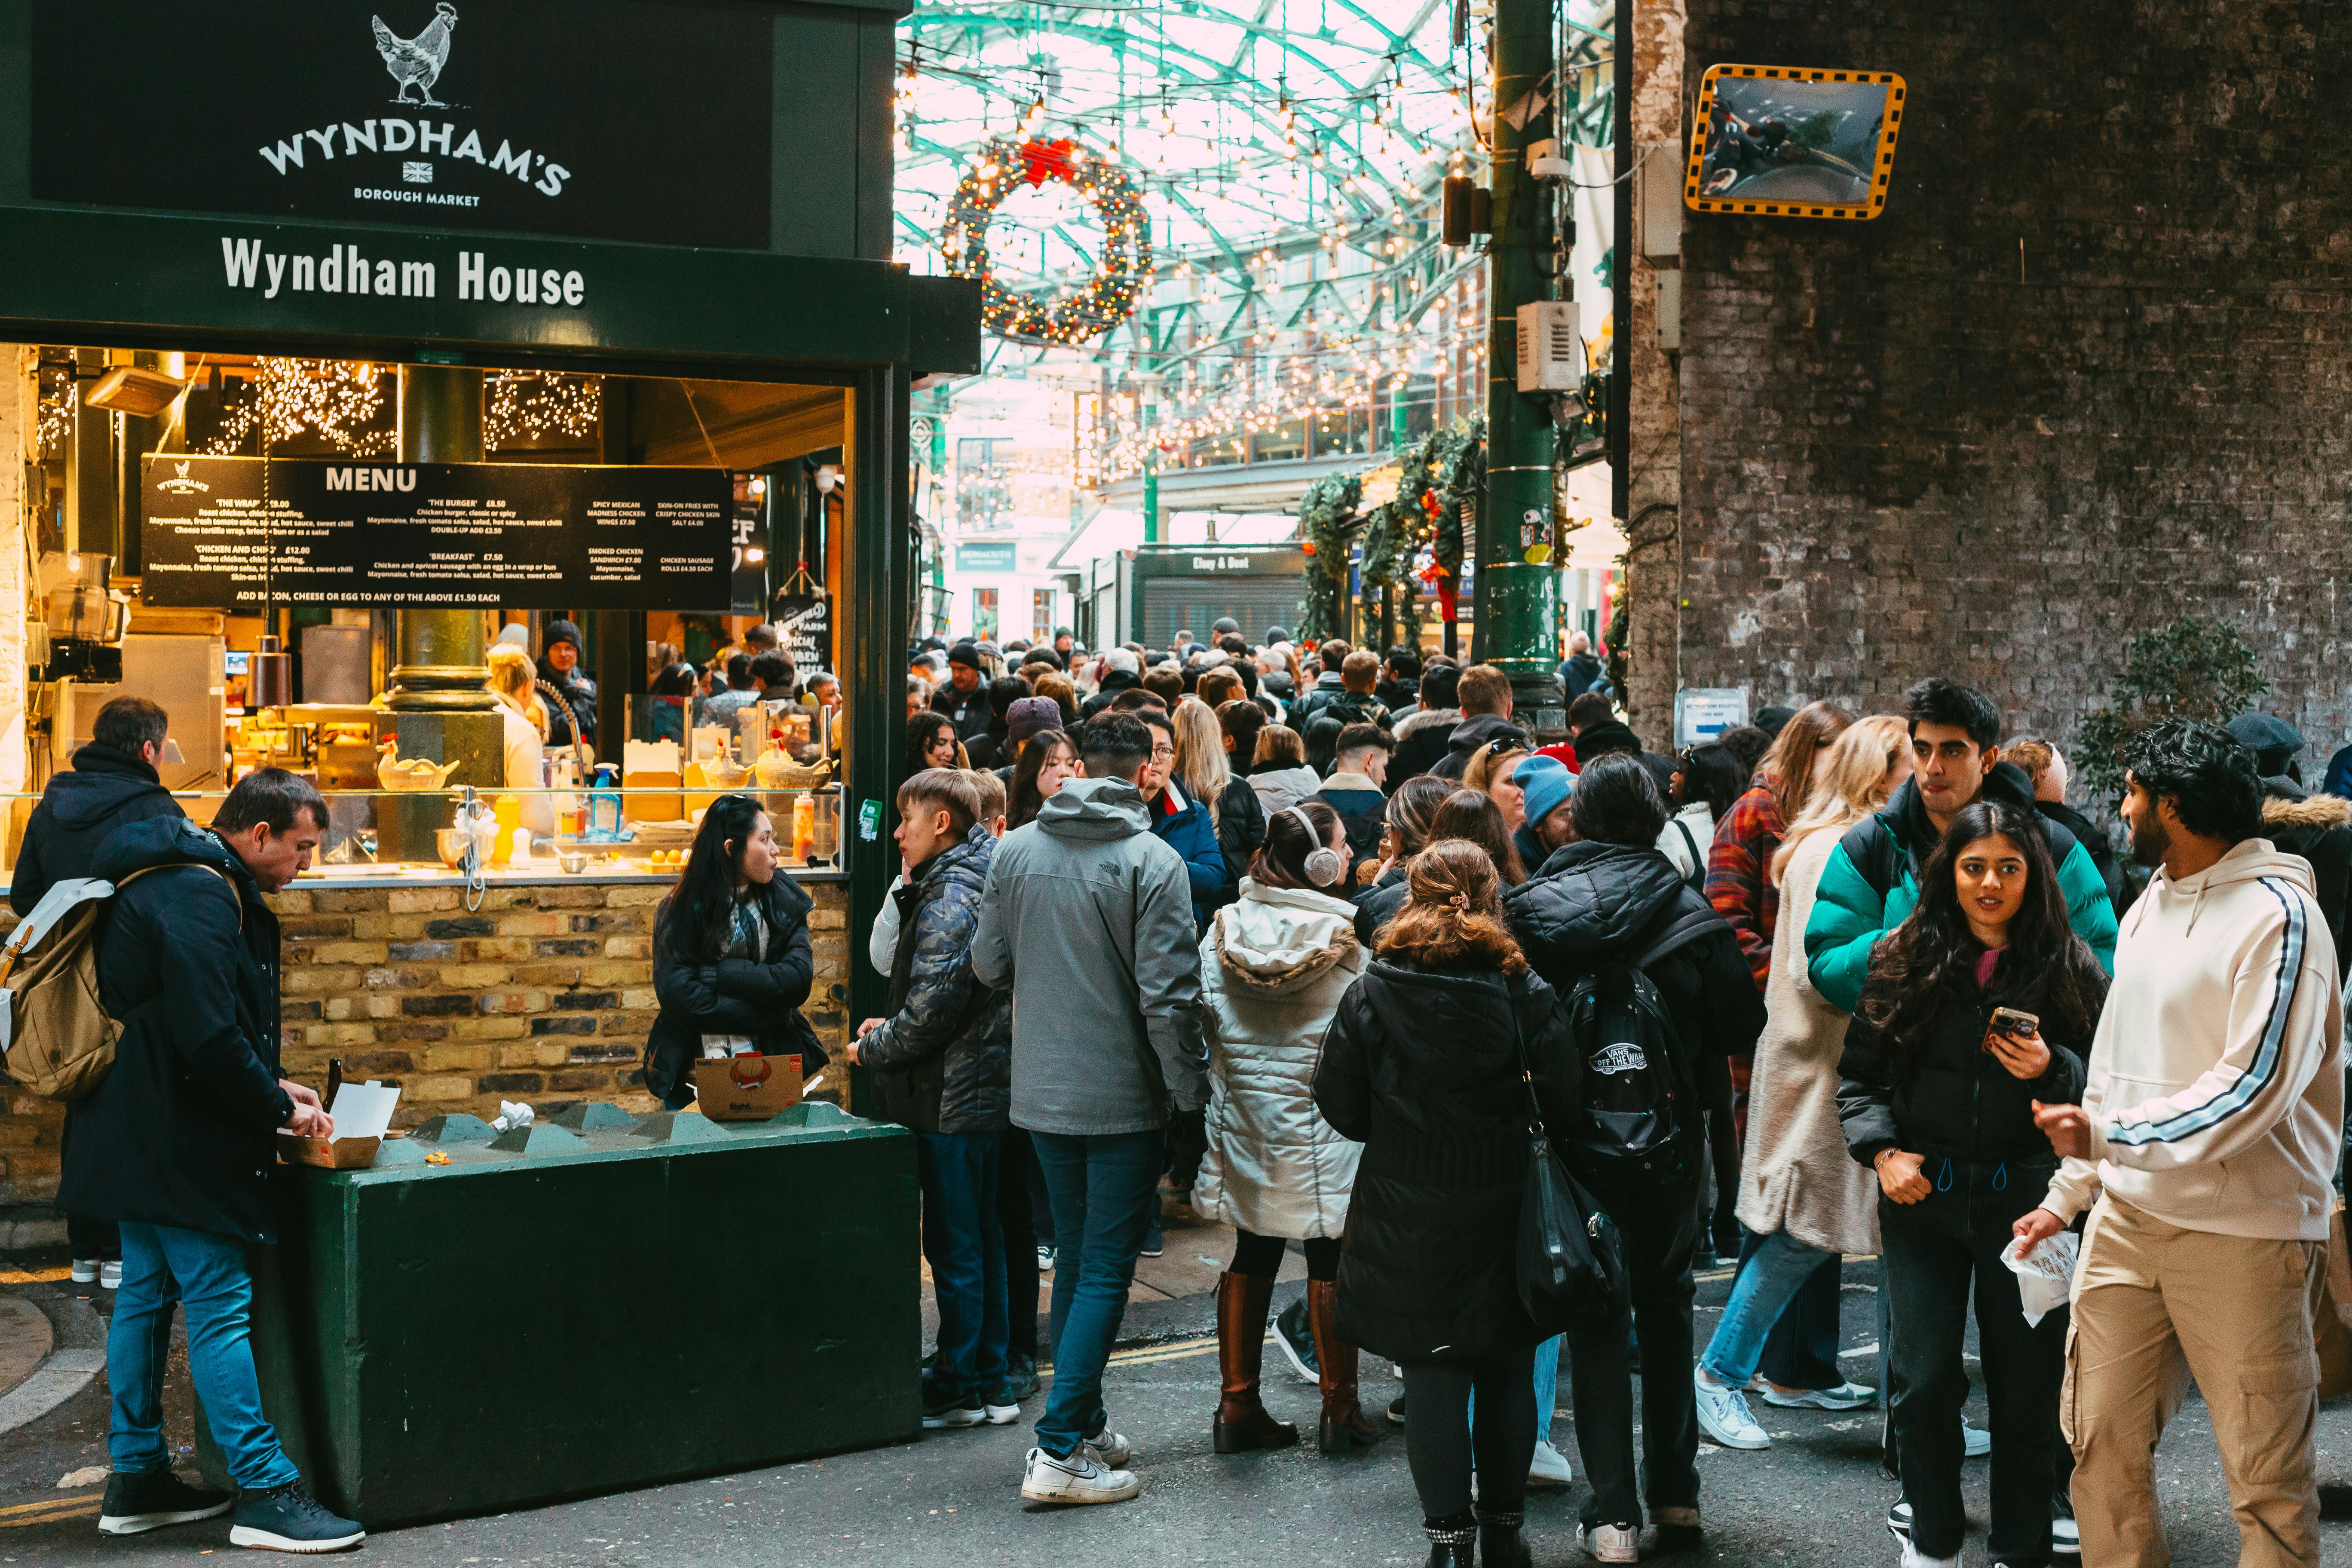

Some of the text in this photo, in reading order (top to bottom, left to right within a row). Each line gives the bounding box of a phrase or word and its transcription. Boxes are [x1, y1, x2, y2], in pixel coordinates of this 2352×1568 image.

[259, 118, 571, 197] WYNDHAM'S
[354, 187, 480, 207] BOROUGH MARKET
[221, 237, 585, 306] Wyndham House
[157, 478, 209, 492] WYNDHAM'S
[326, 467, 417, 492] MENU
[219, 509, 248, 518] chicken,
[444, 509, 468, 518] burger,
[499, 510, 516, 518] spicy
[149, 517, 193, 526] Mayonnaise,
[194, 517, 212, 525] fresh
[285, 546, 310, 554] £12.00
[149, 563, 193, 572] Mayonnaise,
[1217, 556, 1225, 569] &
[236, 591, 256, 600] ADD
[294, 592, 325, 600] CHEESE
[341, 593, 358, 601] EGG
[360, 593, 372, 601] TO
[374, 593, 392, 601] ANY
[1606, 1047, 1629, 1058] VANS
[1611, 1055, 1628, 1065] THE
[2031, 1246, 2071, 1268] BREAD
